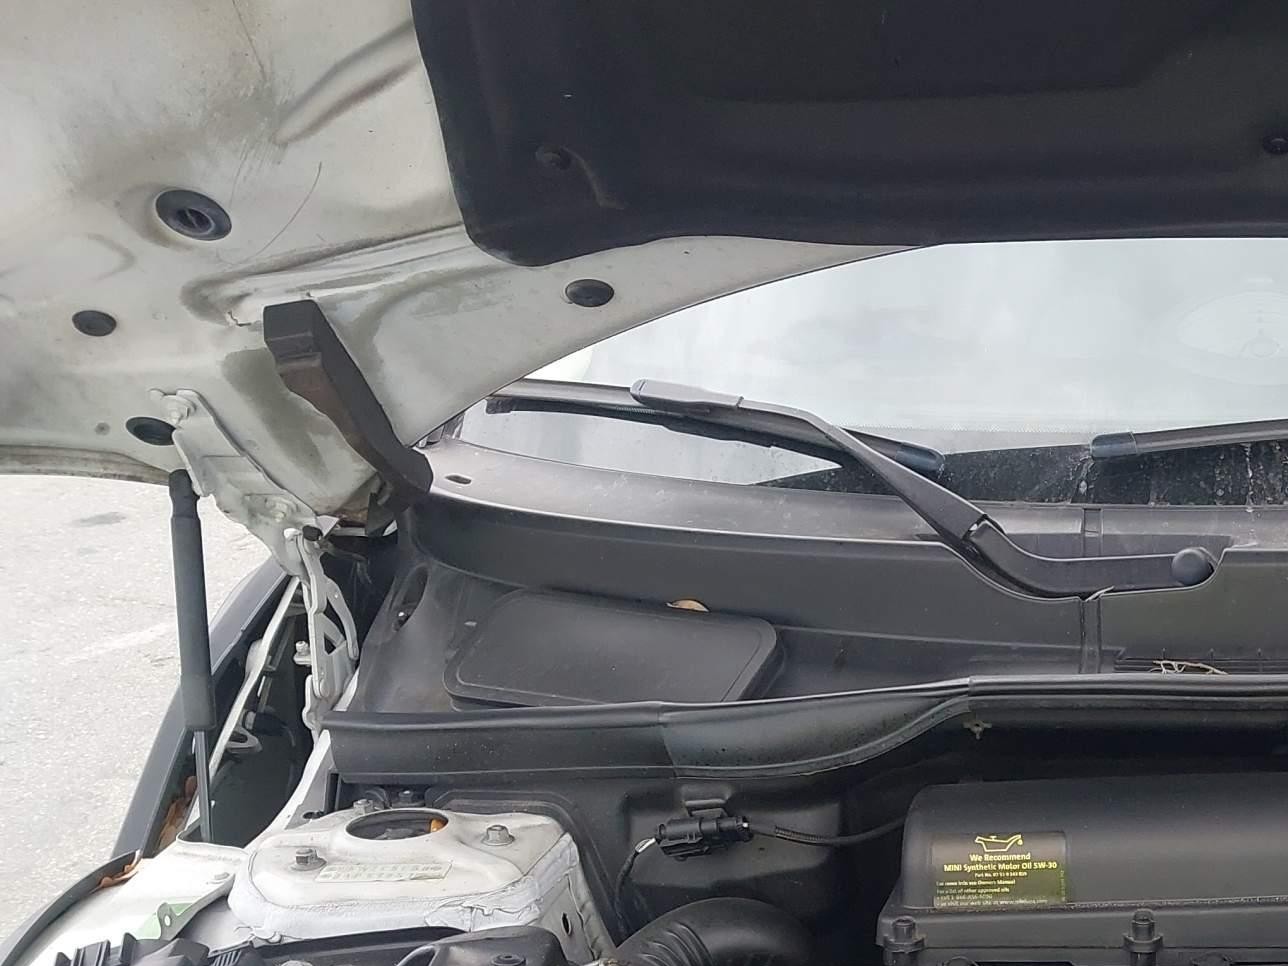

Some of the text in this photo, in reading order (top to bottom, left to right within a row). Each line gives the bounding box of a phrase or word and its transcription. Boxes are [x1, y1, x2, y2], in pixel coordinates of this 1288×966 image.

[969, 852, 1031, 862] We Recommend
[944, 864, 962, 872] MINI
[963, 863, 997, 873] Synthetic
[1021, 862, 1032, 870] Oil
[1033, 861, 1058, 870] 5W-30
